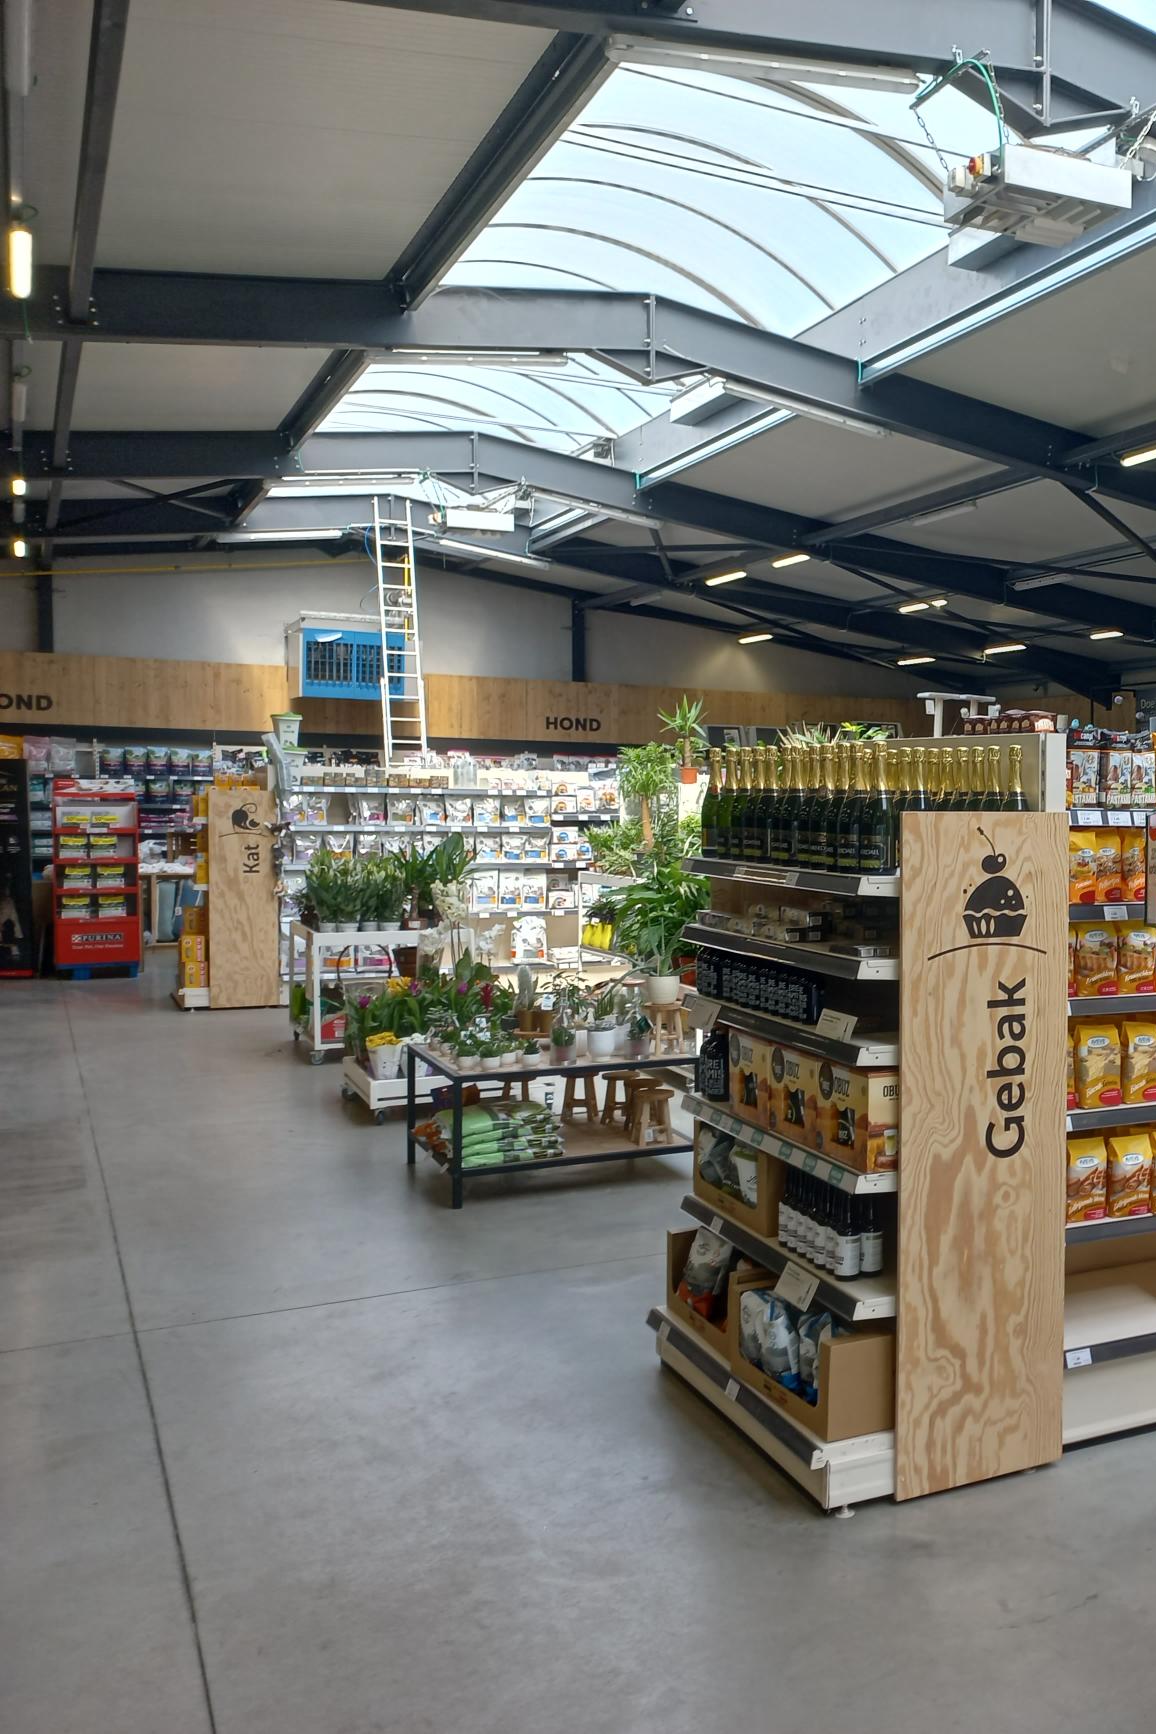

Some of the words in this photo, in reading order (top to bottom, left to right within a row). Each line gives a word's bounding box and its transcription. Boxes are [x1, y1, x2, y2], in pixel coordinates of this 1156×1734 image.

[0, 694, 53, 711] OND
[545, 717, 601, 731] HOND
[243, 844, 260, 873] Kat
[786, 1059, 800, 1080] OBUZ
[985, 977, 1026, 1158] Gebak
[834, 1076, 851, 1097] OBUZ
[882, 1085, 899, 1097] OBU
